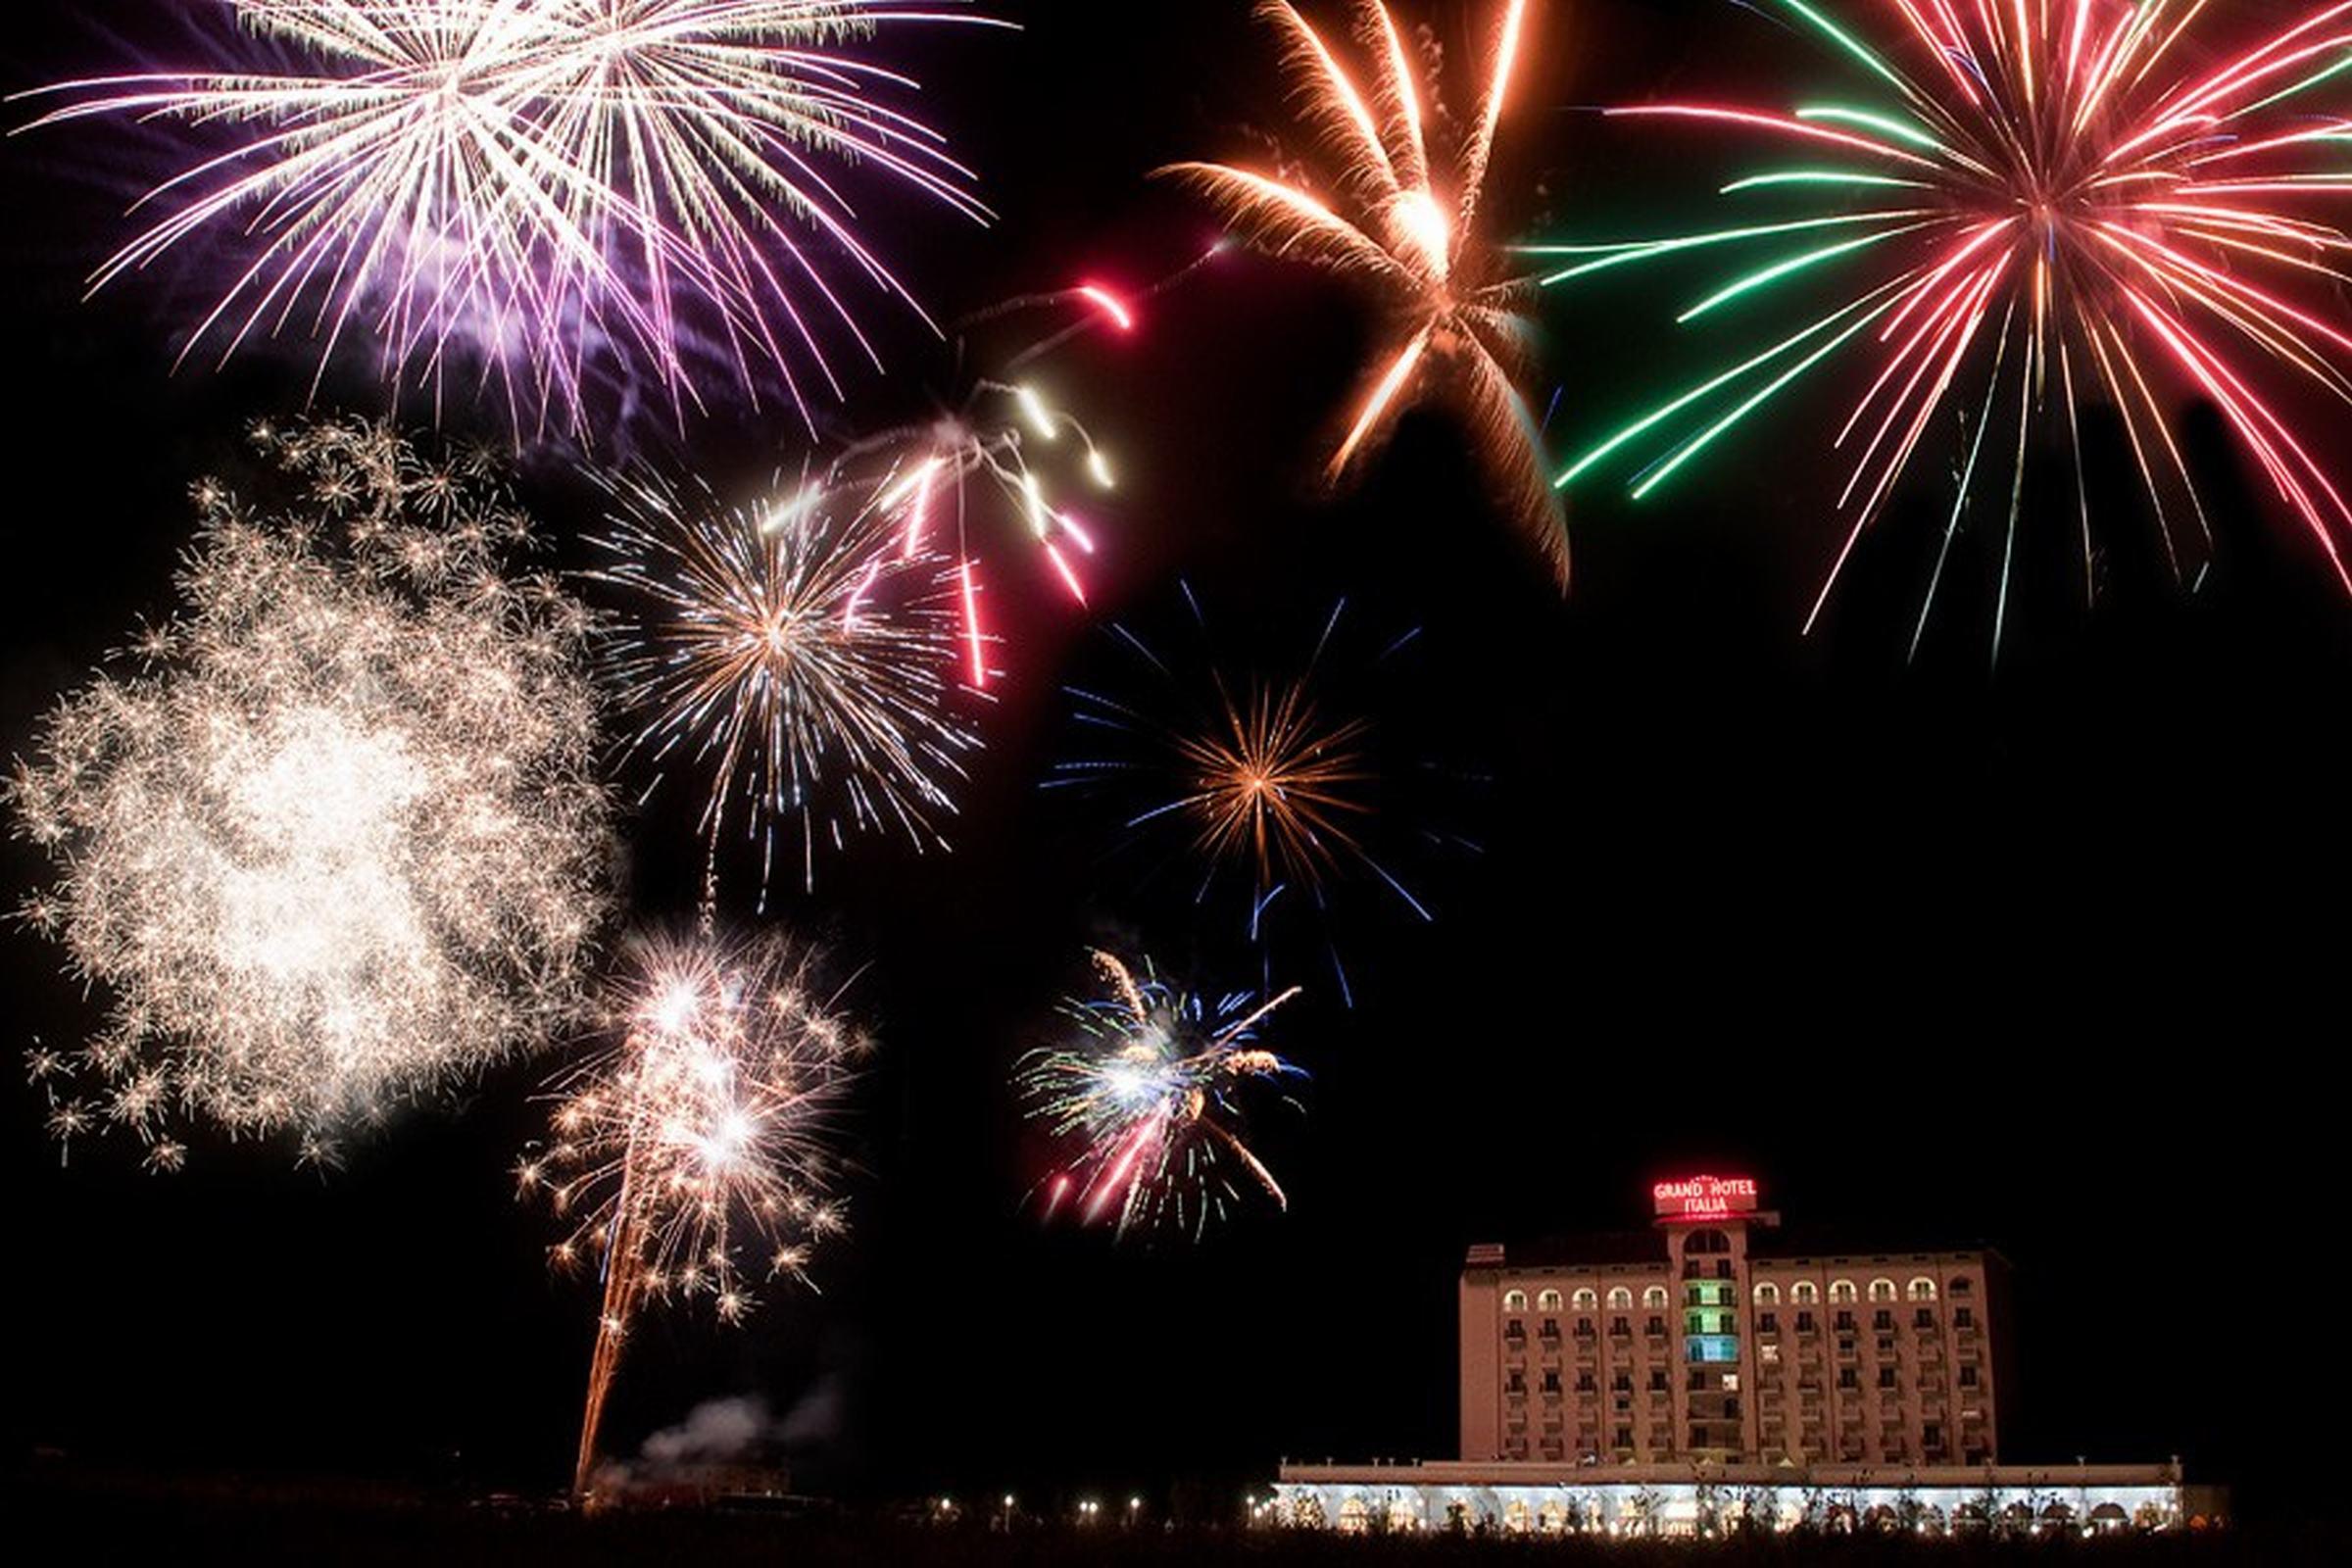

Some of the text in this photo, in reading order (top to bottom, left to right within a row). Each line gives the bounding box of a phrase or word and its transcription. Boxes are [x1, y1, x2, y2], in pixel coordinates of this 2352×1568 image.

[1653, 1179, 1757, 1200] GRAND HOTEL
[1684, 1197, 1728, 1213] ITALIA
